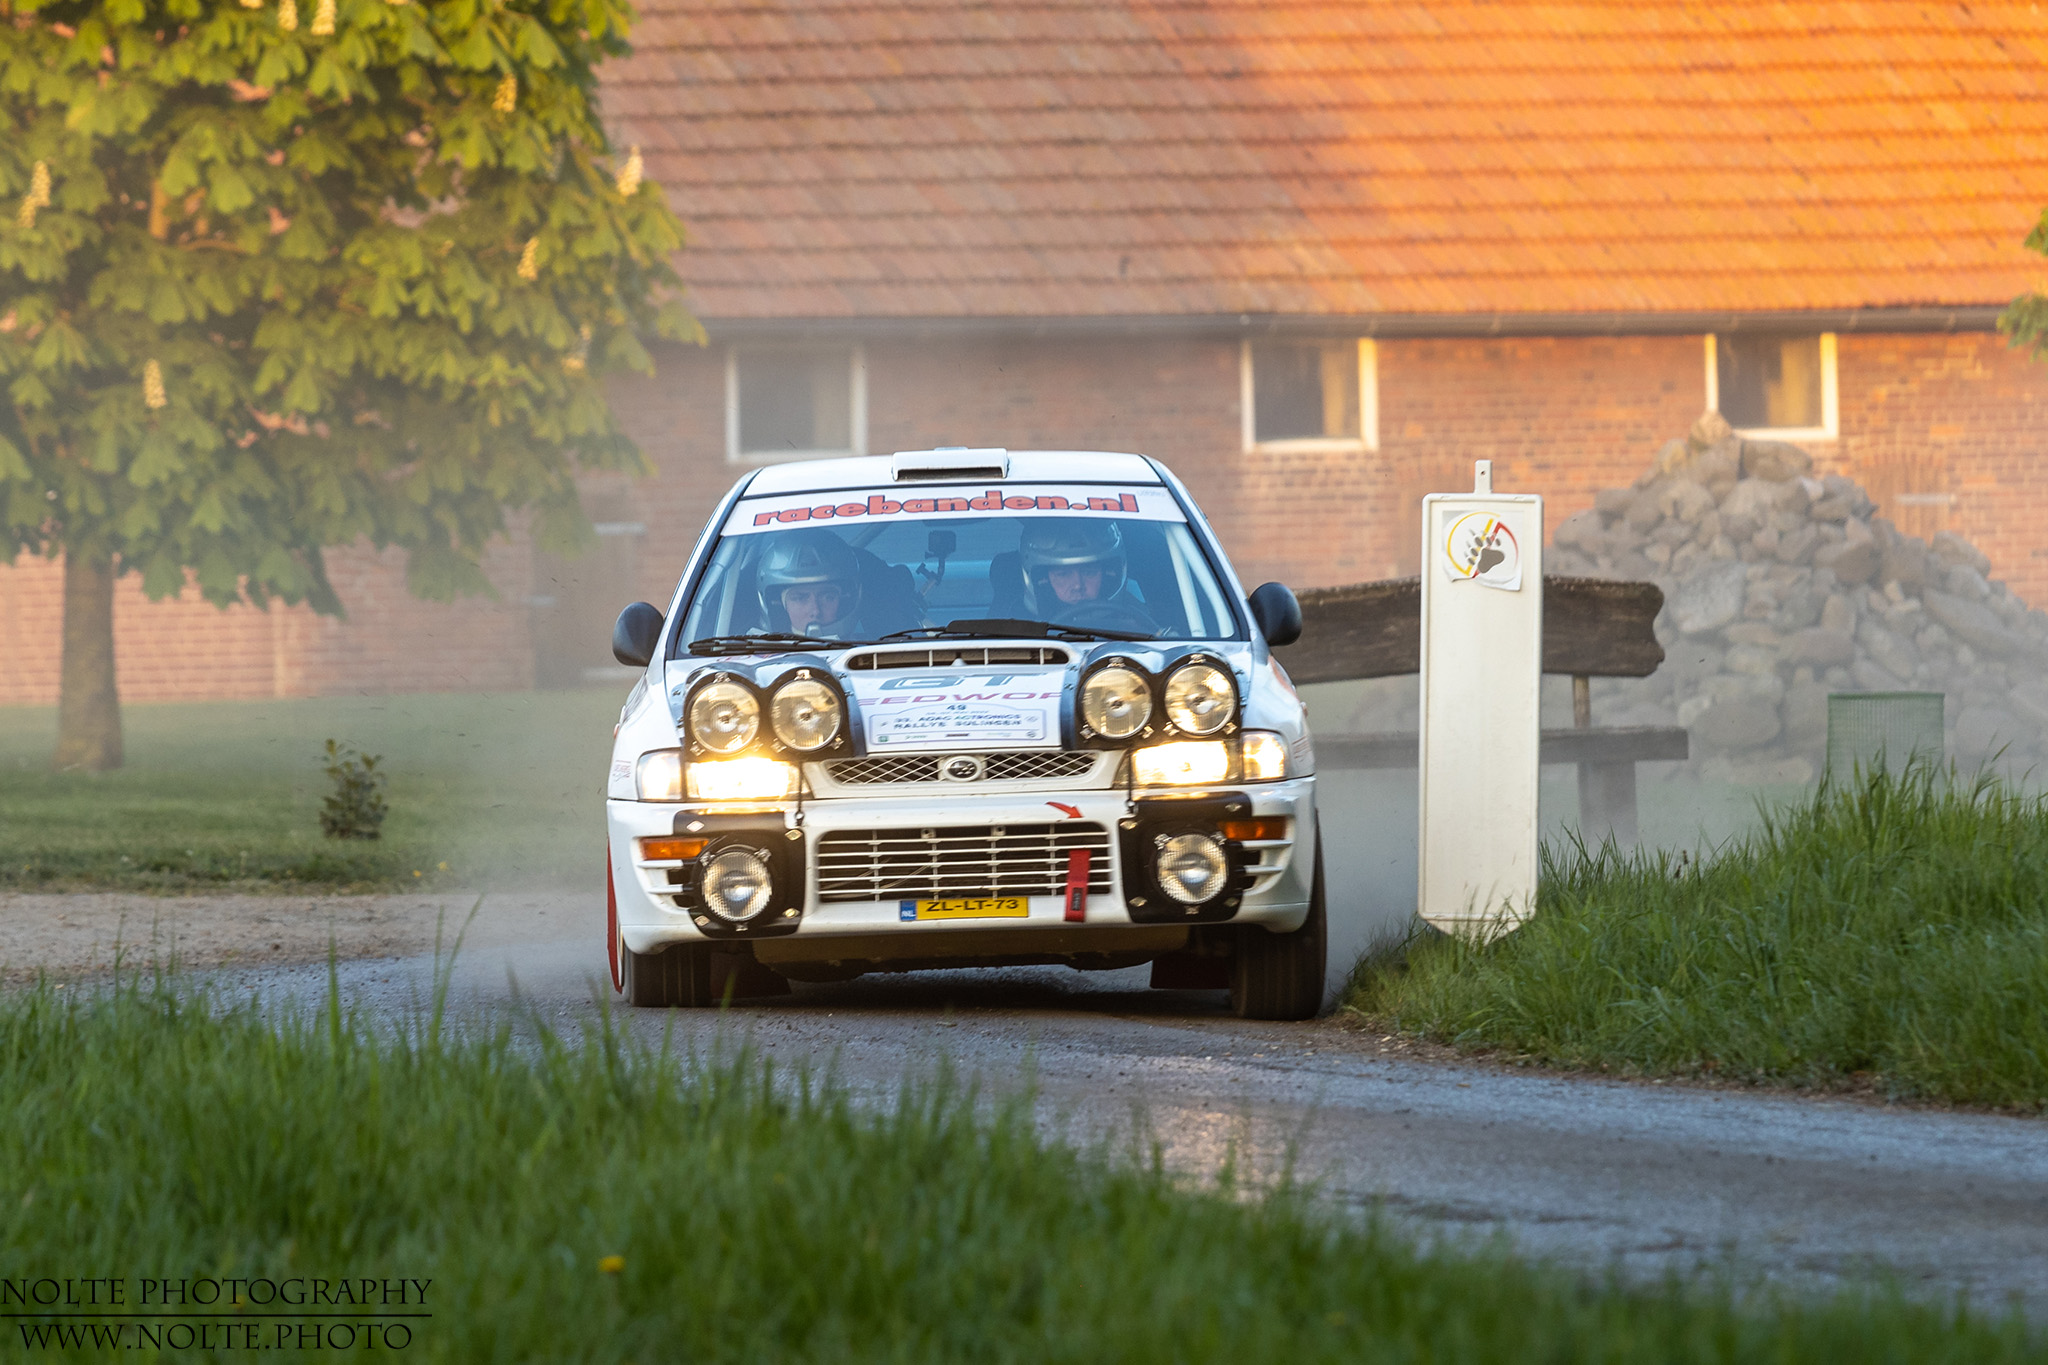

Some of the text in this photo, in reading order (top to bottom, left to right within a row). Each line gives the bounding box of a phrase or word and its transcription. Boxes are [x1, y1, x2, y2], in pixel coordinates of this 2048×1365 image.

[753, 490, 1139, 527] racebanden.nl
[893, 721, 946, 729] RALLYE
[926, 899, 1019, 912] ZL-LT-73
